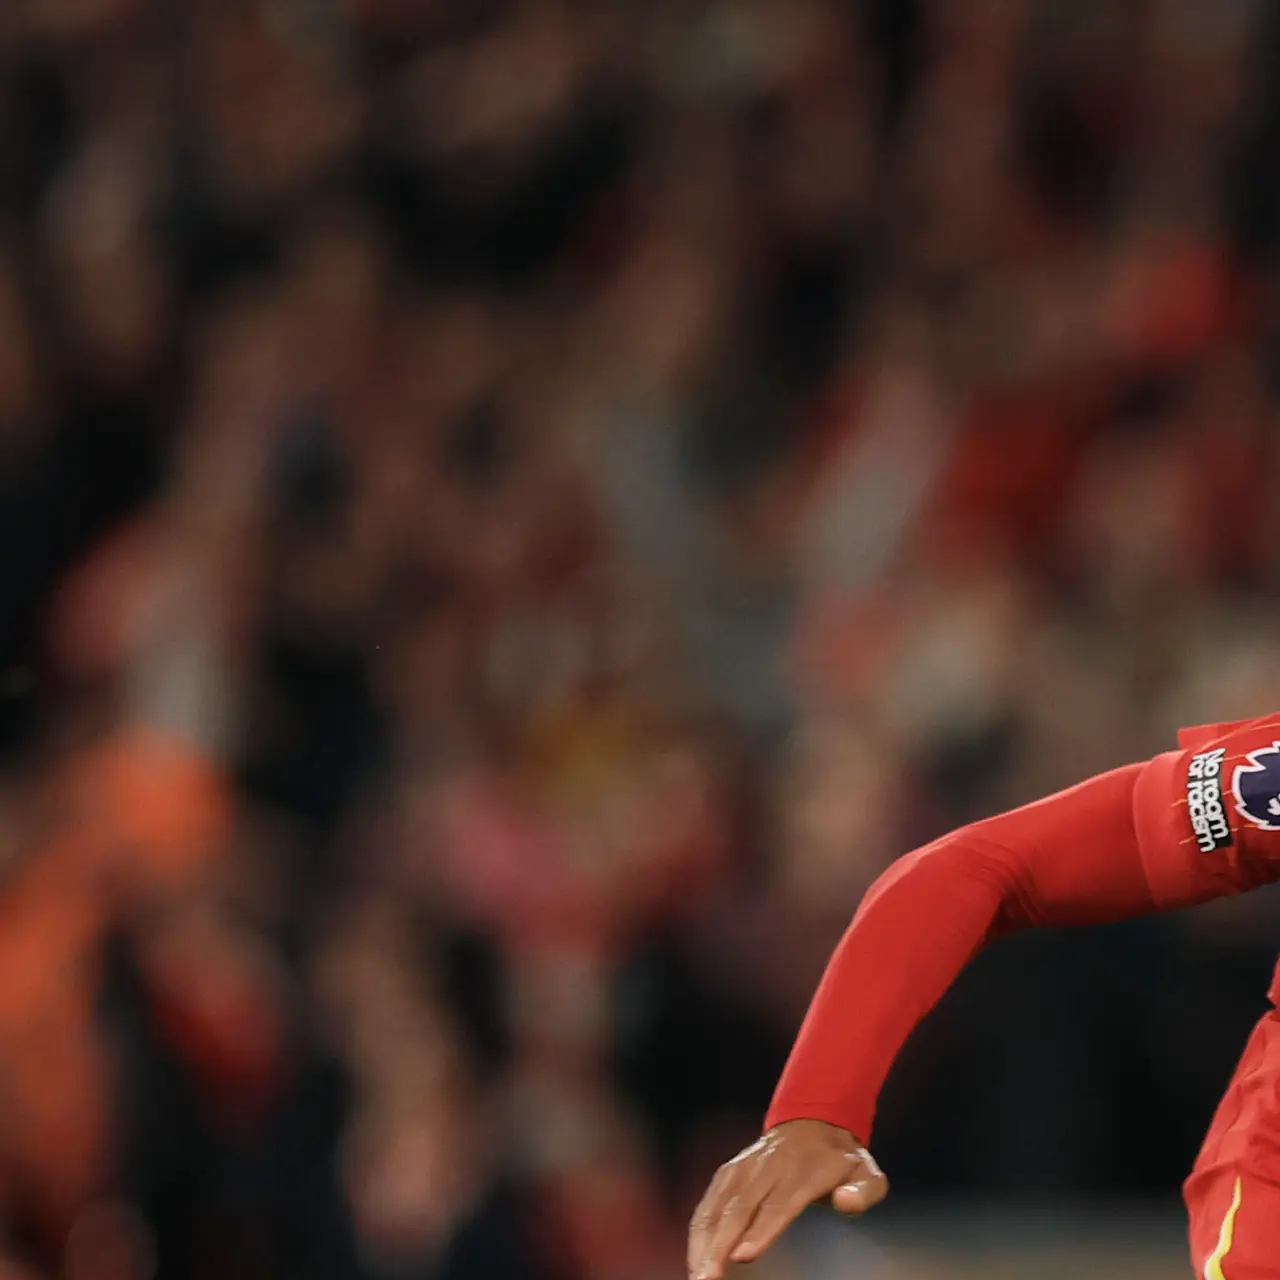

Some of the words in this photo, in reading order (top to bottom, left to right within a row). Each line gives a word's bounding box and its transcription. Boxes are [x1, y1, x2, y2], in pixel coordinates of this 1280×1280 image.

[1203, 748, 1226, 778] No
[1187, 781, 1216, 853] racism
[1203, 779, 1229, 838] room
